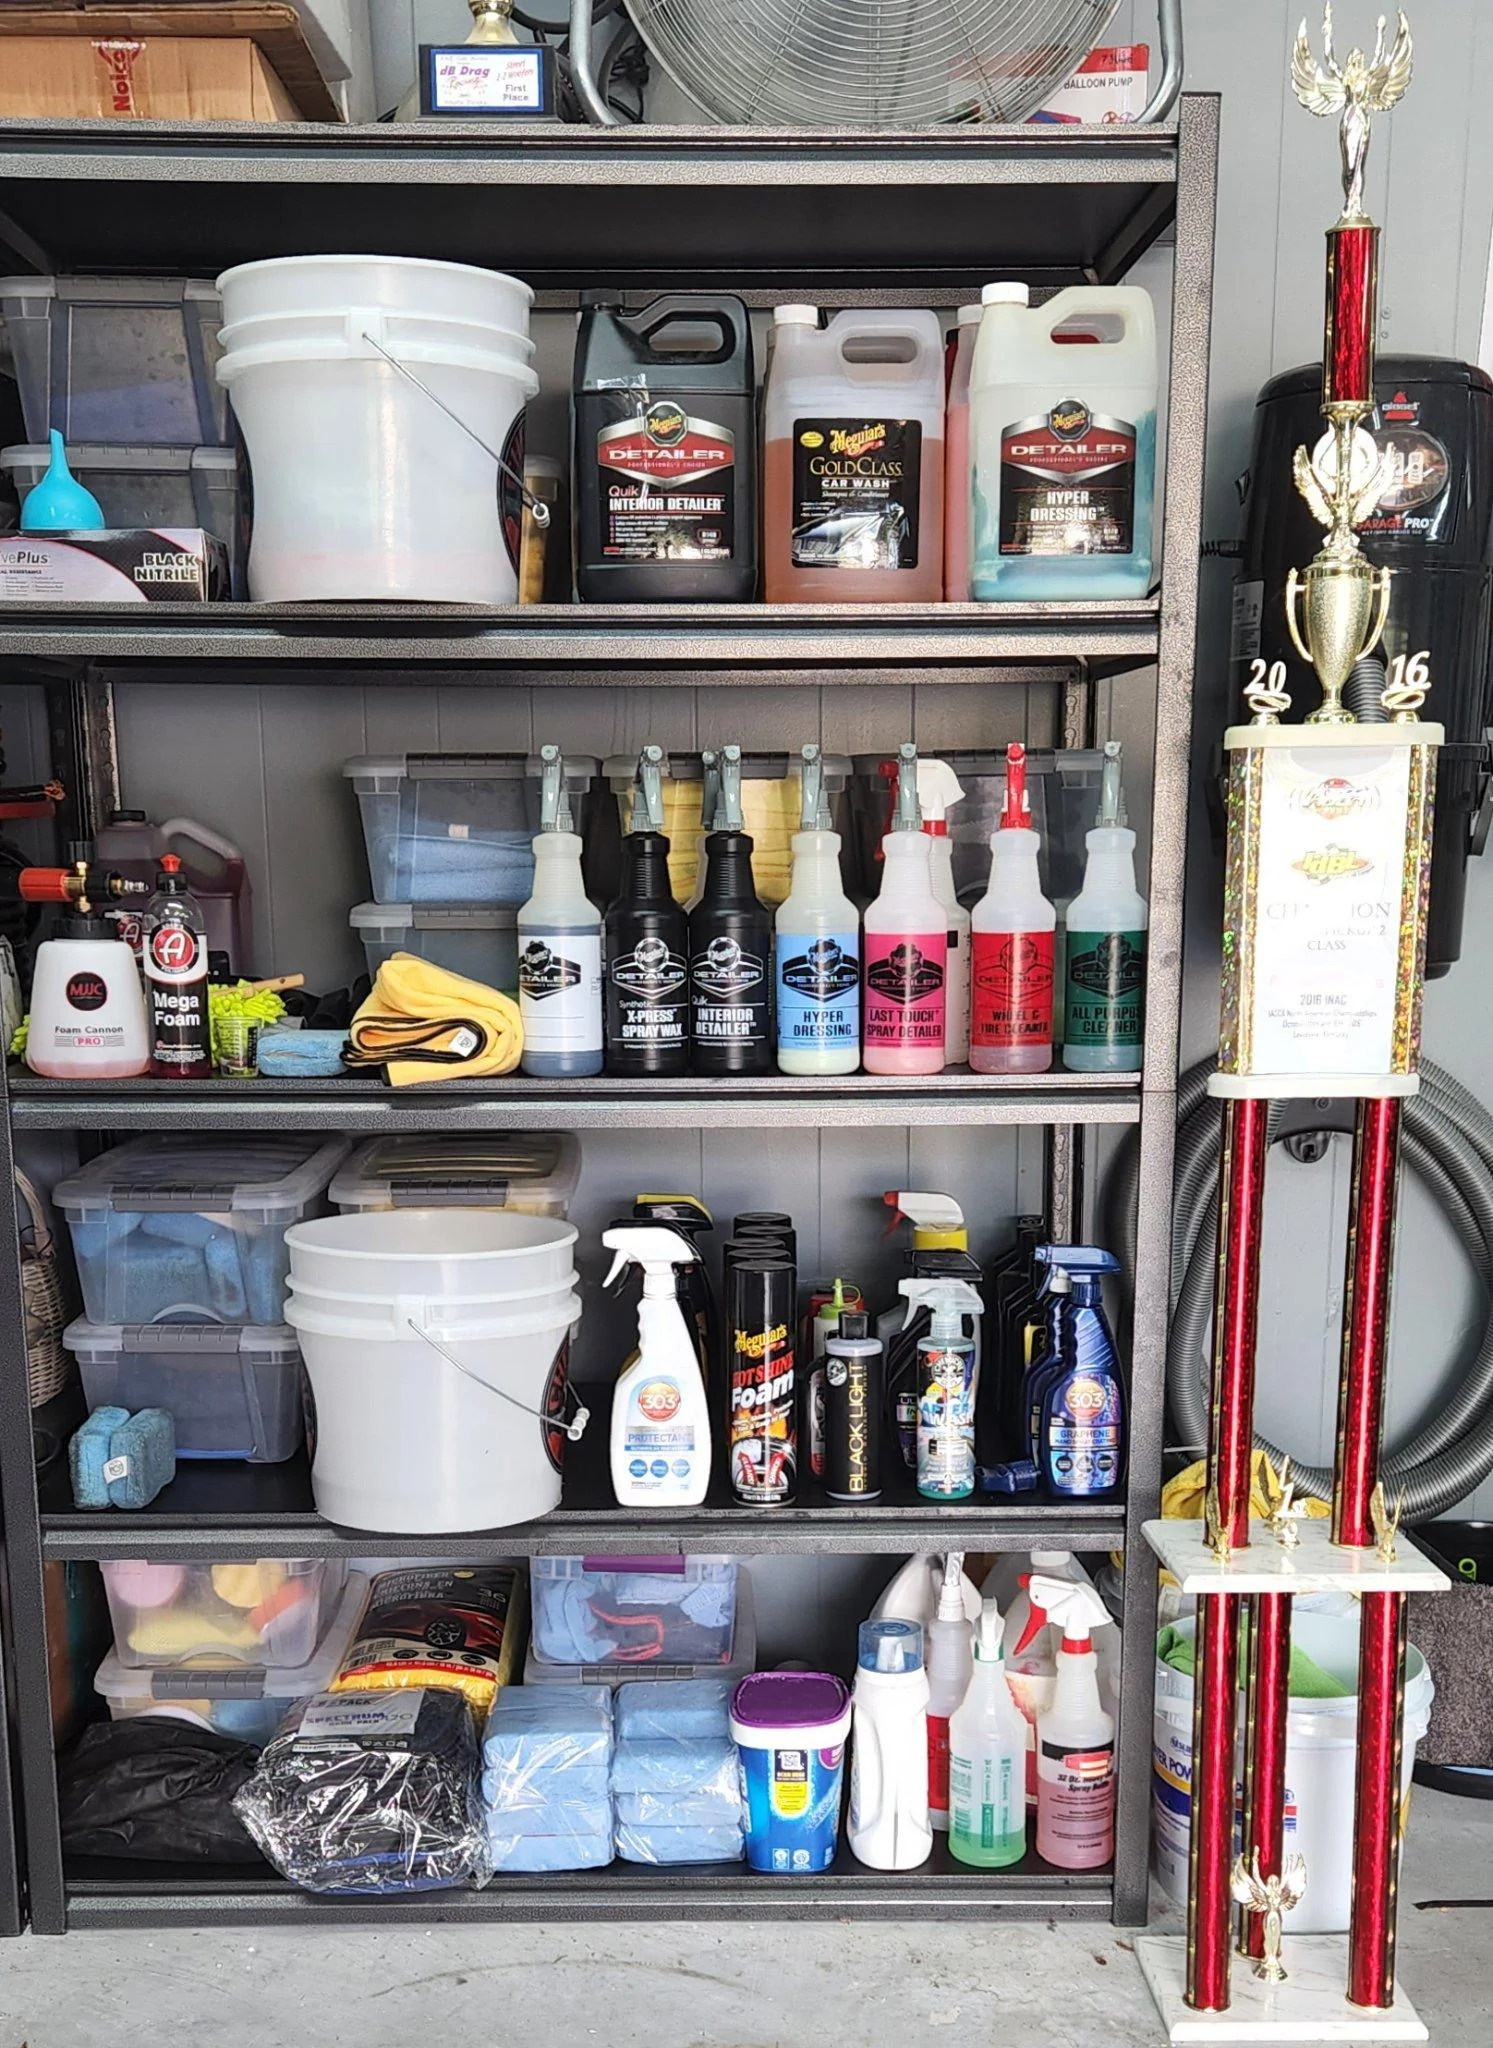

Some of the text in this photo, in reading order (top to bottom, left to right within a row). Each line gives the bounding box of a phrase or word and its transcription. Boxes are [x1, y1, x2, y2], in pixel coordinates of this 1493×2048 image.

[440, 65, 490, 78] dB Drag
[505, 84, 527, 93] First
[1064, 77, 1134, 90] BALLOON PUMP
[503, 93, 530, 102] Place
[830, 423, 886, 454] Meguiar's
[608, 449, 725, 461] DETAILER
[1010, 443, 1128, 456] DETAILER
[821, 479, 890, 488] CAR WASH
[608, 485, 640, 498] Quik
[1046, 490, 1090, 505] HYPER
[609, 498, 724, 511] INTERIOR DETAILER
[1030, 507, 1100, 521] DRESSING
[1403, 517, 1431, 529] PRO
[144, 553, 198, 567] BLACK
[134, 567, 199, 582] NITRILE
[1243, 658, 1287, 693] 20
[1390, 650, 1432, 690] 16
[158, 931, 186, 965] A
[1307, 939, 1347, 951] CLASS
[616, 971, 685, 980] DETAILER
[693, 971, 760, 979] DETAILER
[785, 974, 858, 983] DETAILER
[869, 977, 941, 987] DETAILER
[70, 983, 103, 996] MJJC
[154, 991, 200, 1012] Mega
[154, 1011, 200, 1027] Foam
[626, 1010, 675, 1023] X-PRESS
[697, 1008, 754, 1021] INTERIOR
[803, 1010, 845, 1023] HYPER
[869, 1009, 935, 1023] LAST TOUCH
[1071, 1007, 1090, 1019] ALL
[54, 1025, 124, 1034] Foam Cannon
[622, 1023, 683, 1038] SPRAY WAX
[695, 1021, 751, 1036] DETAILER
[793, 1024, 853, 1037] DRESSING
[867, 1024, 942, 1038] SPRAY DETAILER
[77, 1037, 102, 1046] PRO
[731, 1368, 795, 1412] Foam
[641, 1393, 678, 1410] 303
[1069, 1392, 1103, 1409] 303
[849, 1362, 864, 1492] BLACK LIGHT
[1060, 1429, 1111, 1439] GRAPHENE
[305, 1712, 386, 1724] SPECTRUM
